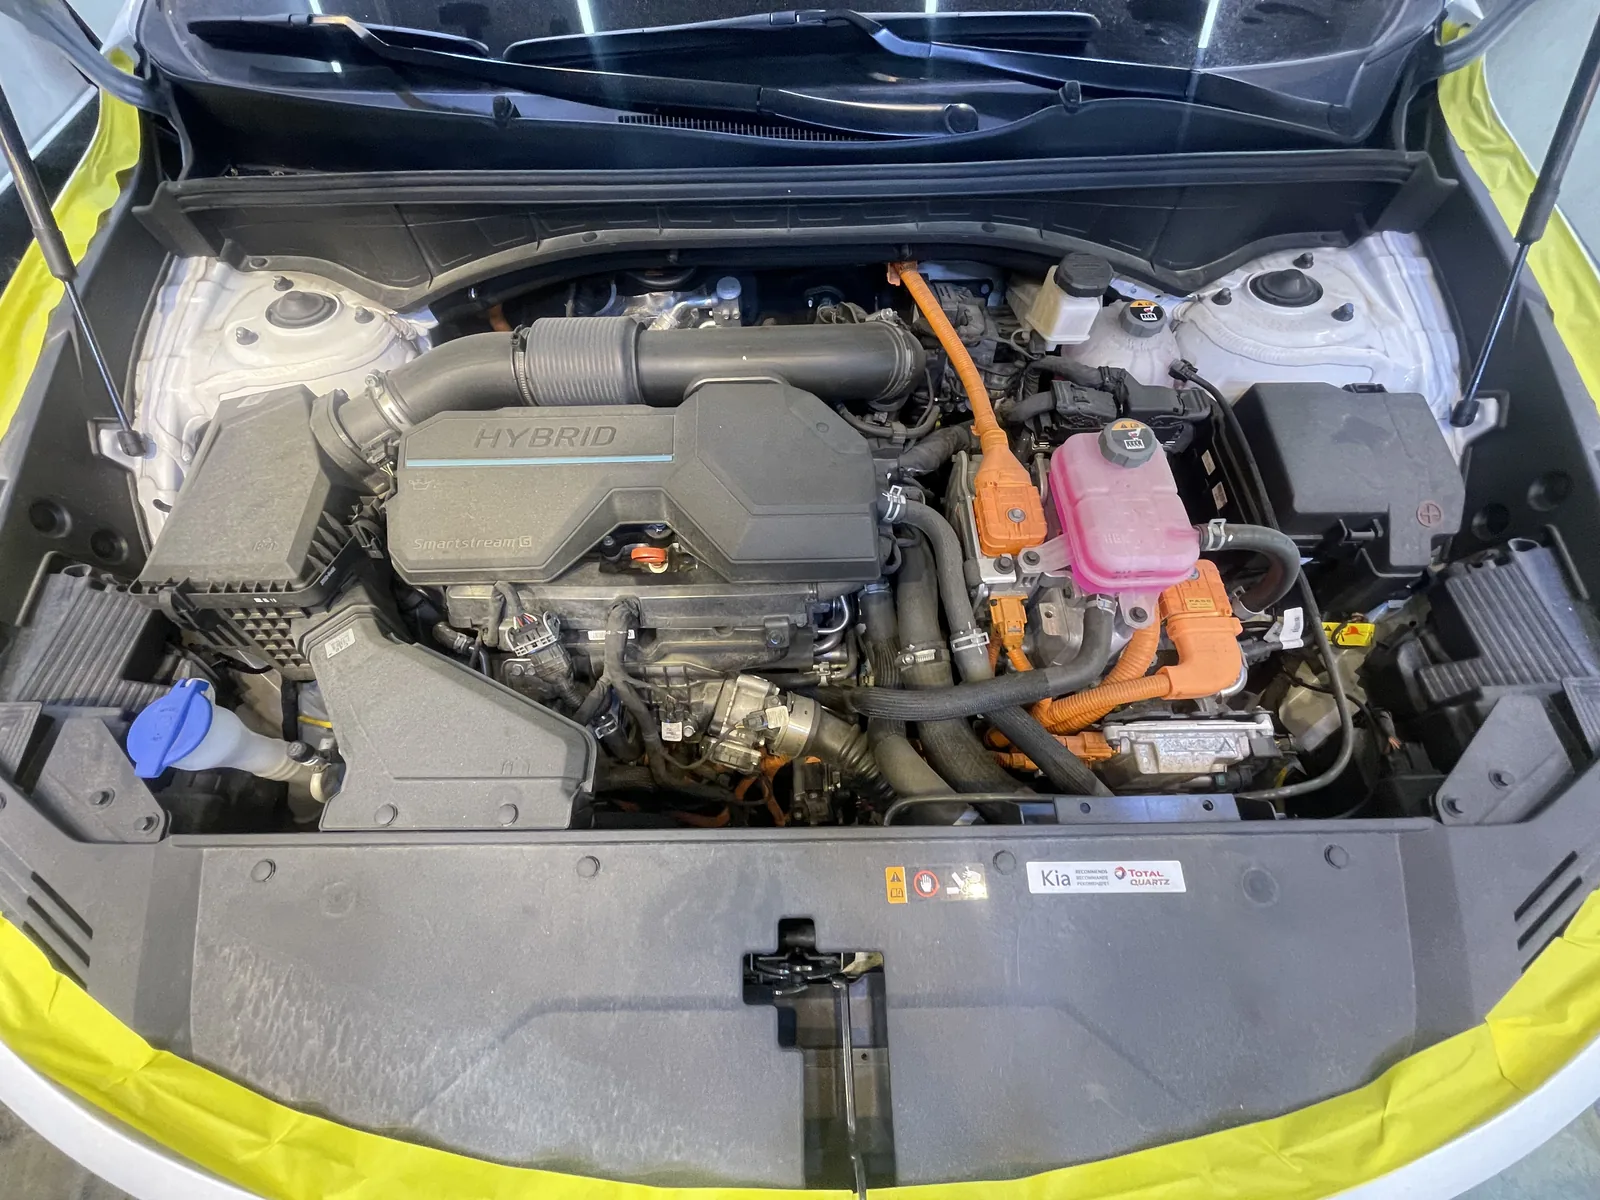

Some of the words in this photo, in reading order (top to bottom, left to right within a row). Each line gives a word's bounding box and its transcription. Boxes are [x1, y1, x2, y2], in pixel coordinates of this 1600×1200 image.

[473, 425, 617, 449] HYBRID
[412, 537, 515, 551] Smartstream
[1041, 869, 1071, 887] Kia
[1130, 878, 1170, 886] QUARTZ
